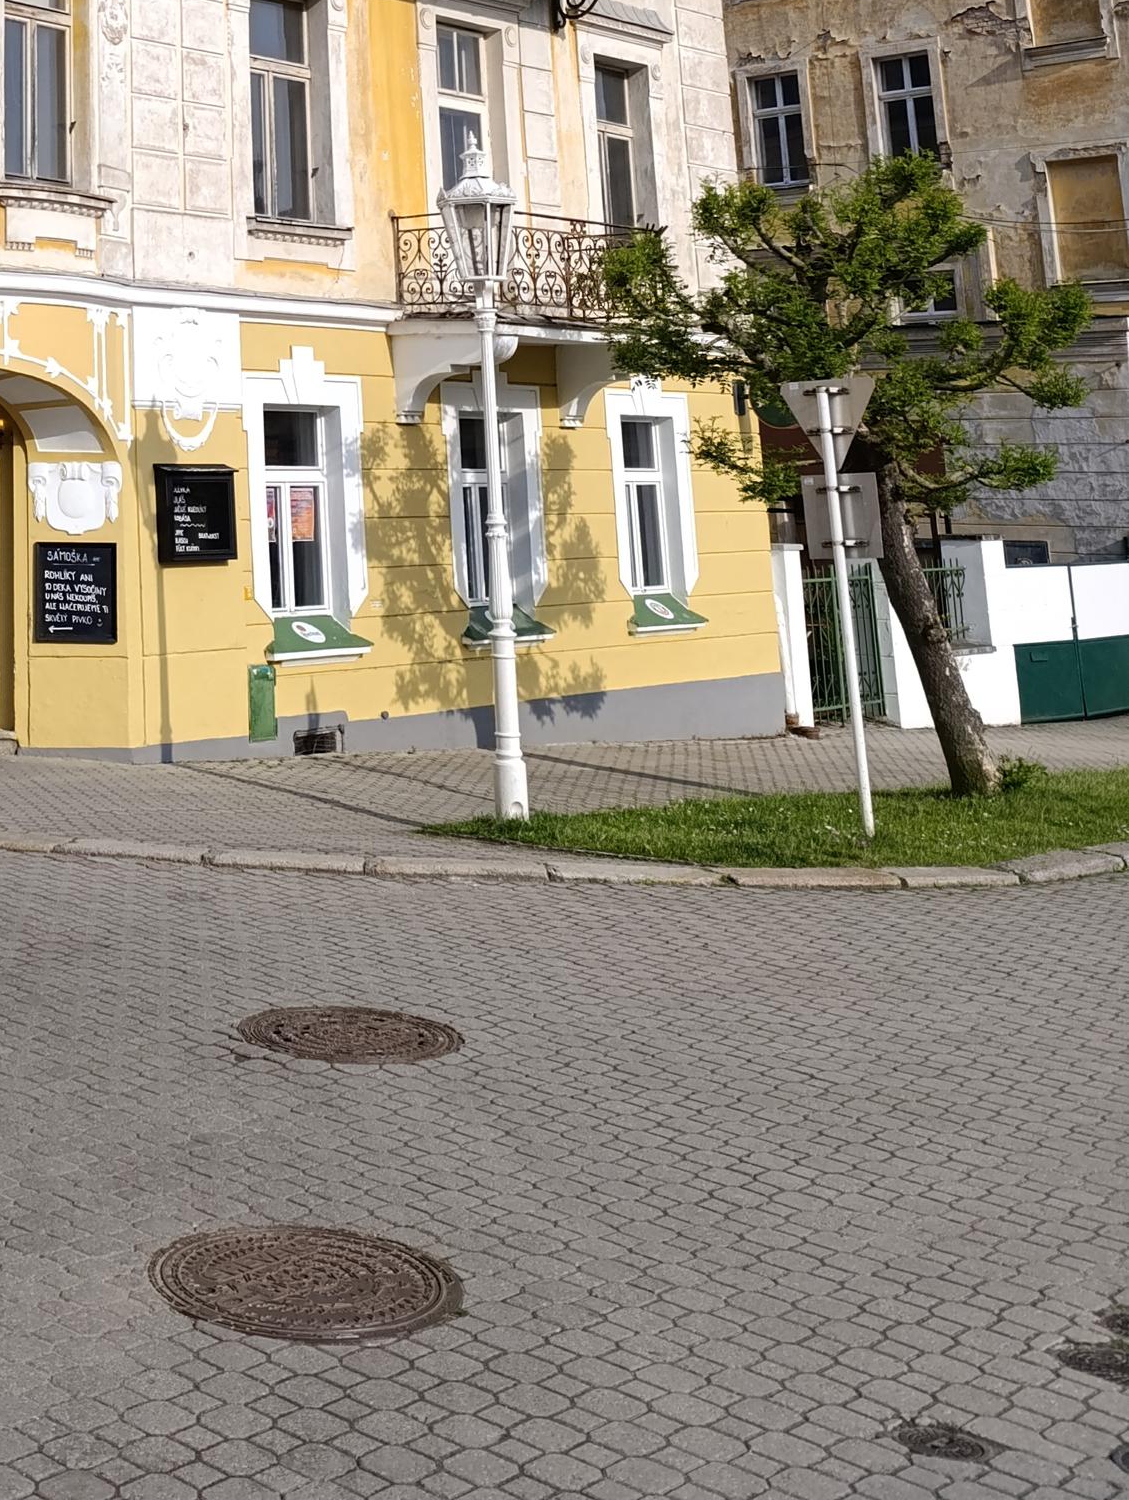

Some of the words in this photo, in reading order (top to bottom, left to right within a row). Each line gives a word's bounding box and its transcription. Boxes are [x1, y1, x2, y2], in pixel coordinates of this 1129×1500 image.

[46, 548, 88, 563] SÁMOŠKA
[44, 569, 77, 581] ROHLÍKY
[80, 573, 94, 582] ANI
[45, 583, 52, 591] 10
[53, 583, 72, 592] DEKA
[45, 592, 51, 600] U
[45, 602, 57, 610] ALE
[71, 614, 93, 625] PIVKO
